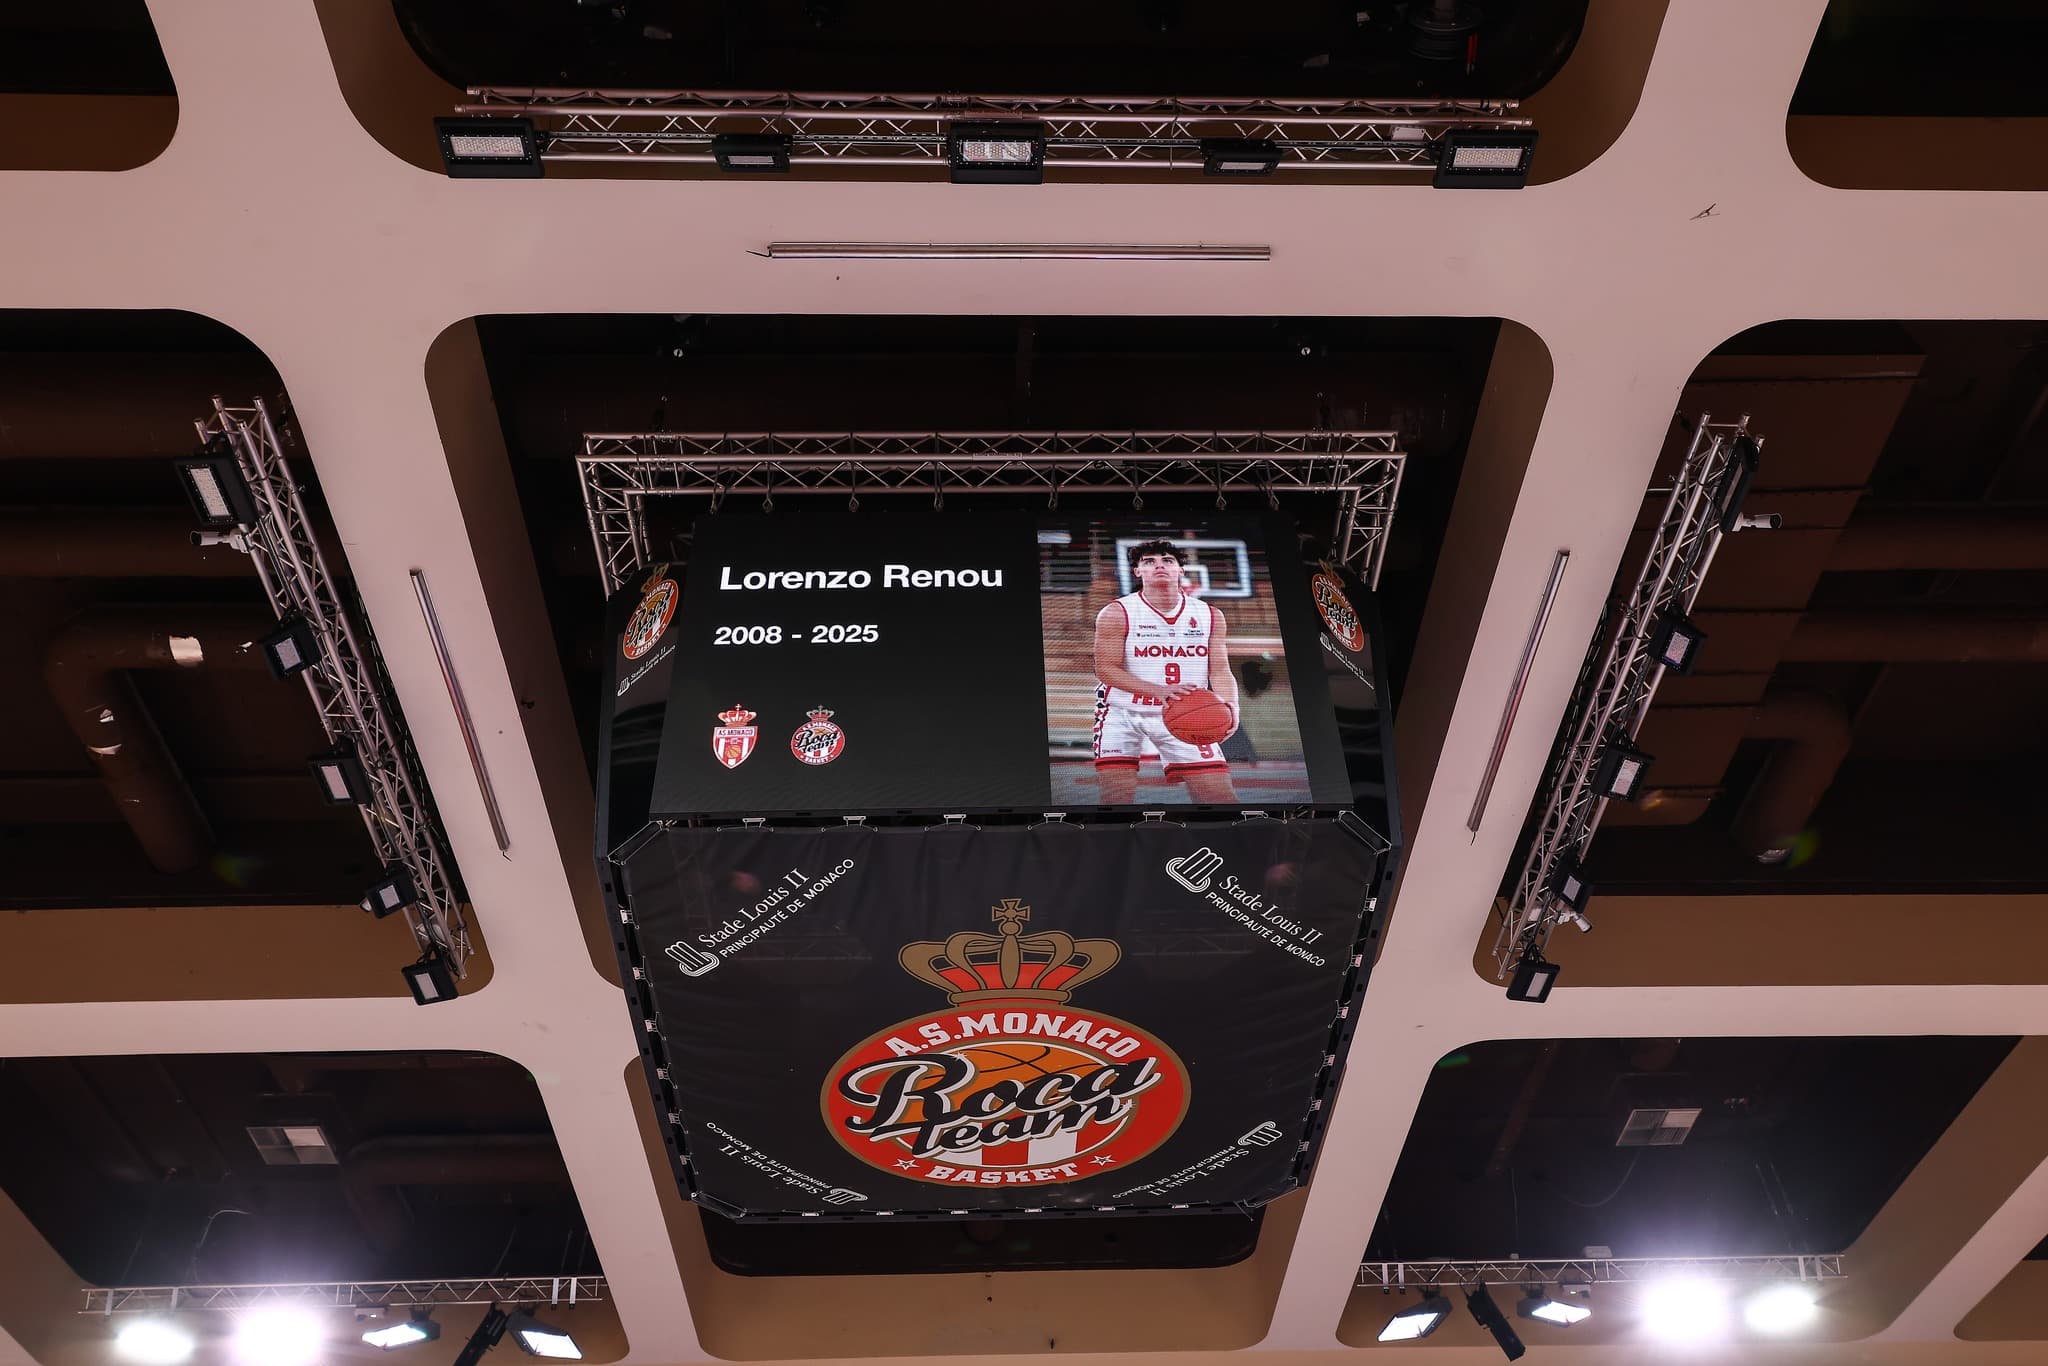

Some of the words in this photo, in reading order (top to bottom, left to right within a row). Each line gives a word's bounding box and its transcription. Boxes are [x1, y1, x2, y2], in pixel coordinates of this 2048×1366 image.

[719, 565, 872, 591] Lorenzo
[883, 563, 1004, 589] Renou
[713, 625, 783, 646] 2008
[810, 624, 880, 644] 2025
[1134, 645, 1209, 658] MONACO
[1165, 662, 1181, 685] 9
[698, 917, 746, 948] Stade
[738, 888, 790, 923] Louis
[783, 867, 810, 890] II
[719, 910, 789, 958] PRINCIPAUTÉ
[786, 898, 806, 914] DE
[803, 858, 855, 900] MONACO
[1218, 875, 1263, 911] Stade
[1261, 904, 1303, 937] Louis
[1300, 927, 1324, 945] II
[1205, 891, 1273, 939] PRINCIPAUTÉ
[1270, 934, 1288, 947] DE
[1284, 943, 1326, 967] MONACO
[838, 1053, 1162, 1134] Roca
[706, 1122, 753, 1152] MONACO
[869, 1096, 1131, 1158] Team
[740, 1154, 783, 1179] Louis
[751, 1150, 768, 1160] DE
[1207, 1148, 1250, 1171] Stade
[782, 1176, 824, 1195] Stade
[924, 1162, 1080, 1185] BASKET
[1154, 1177, 1171, 1186] DE
[1166, 1170, 1210, 1188] Louis
